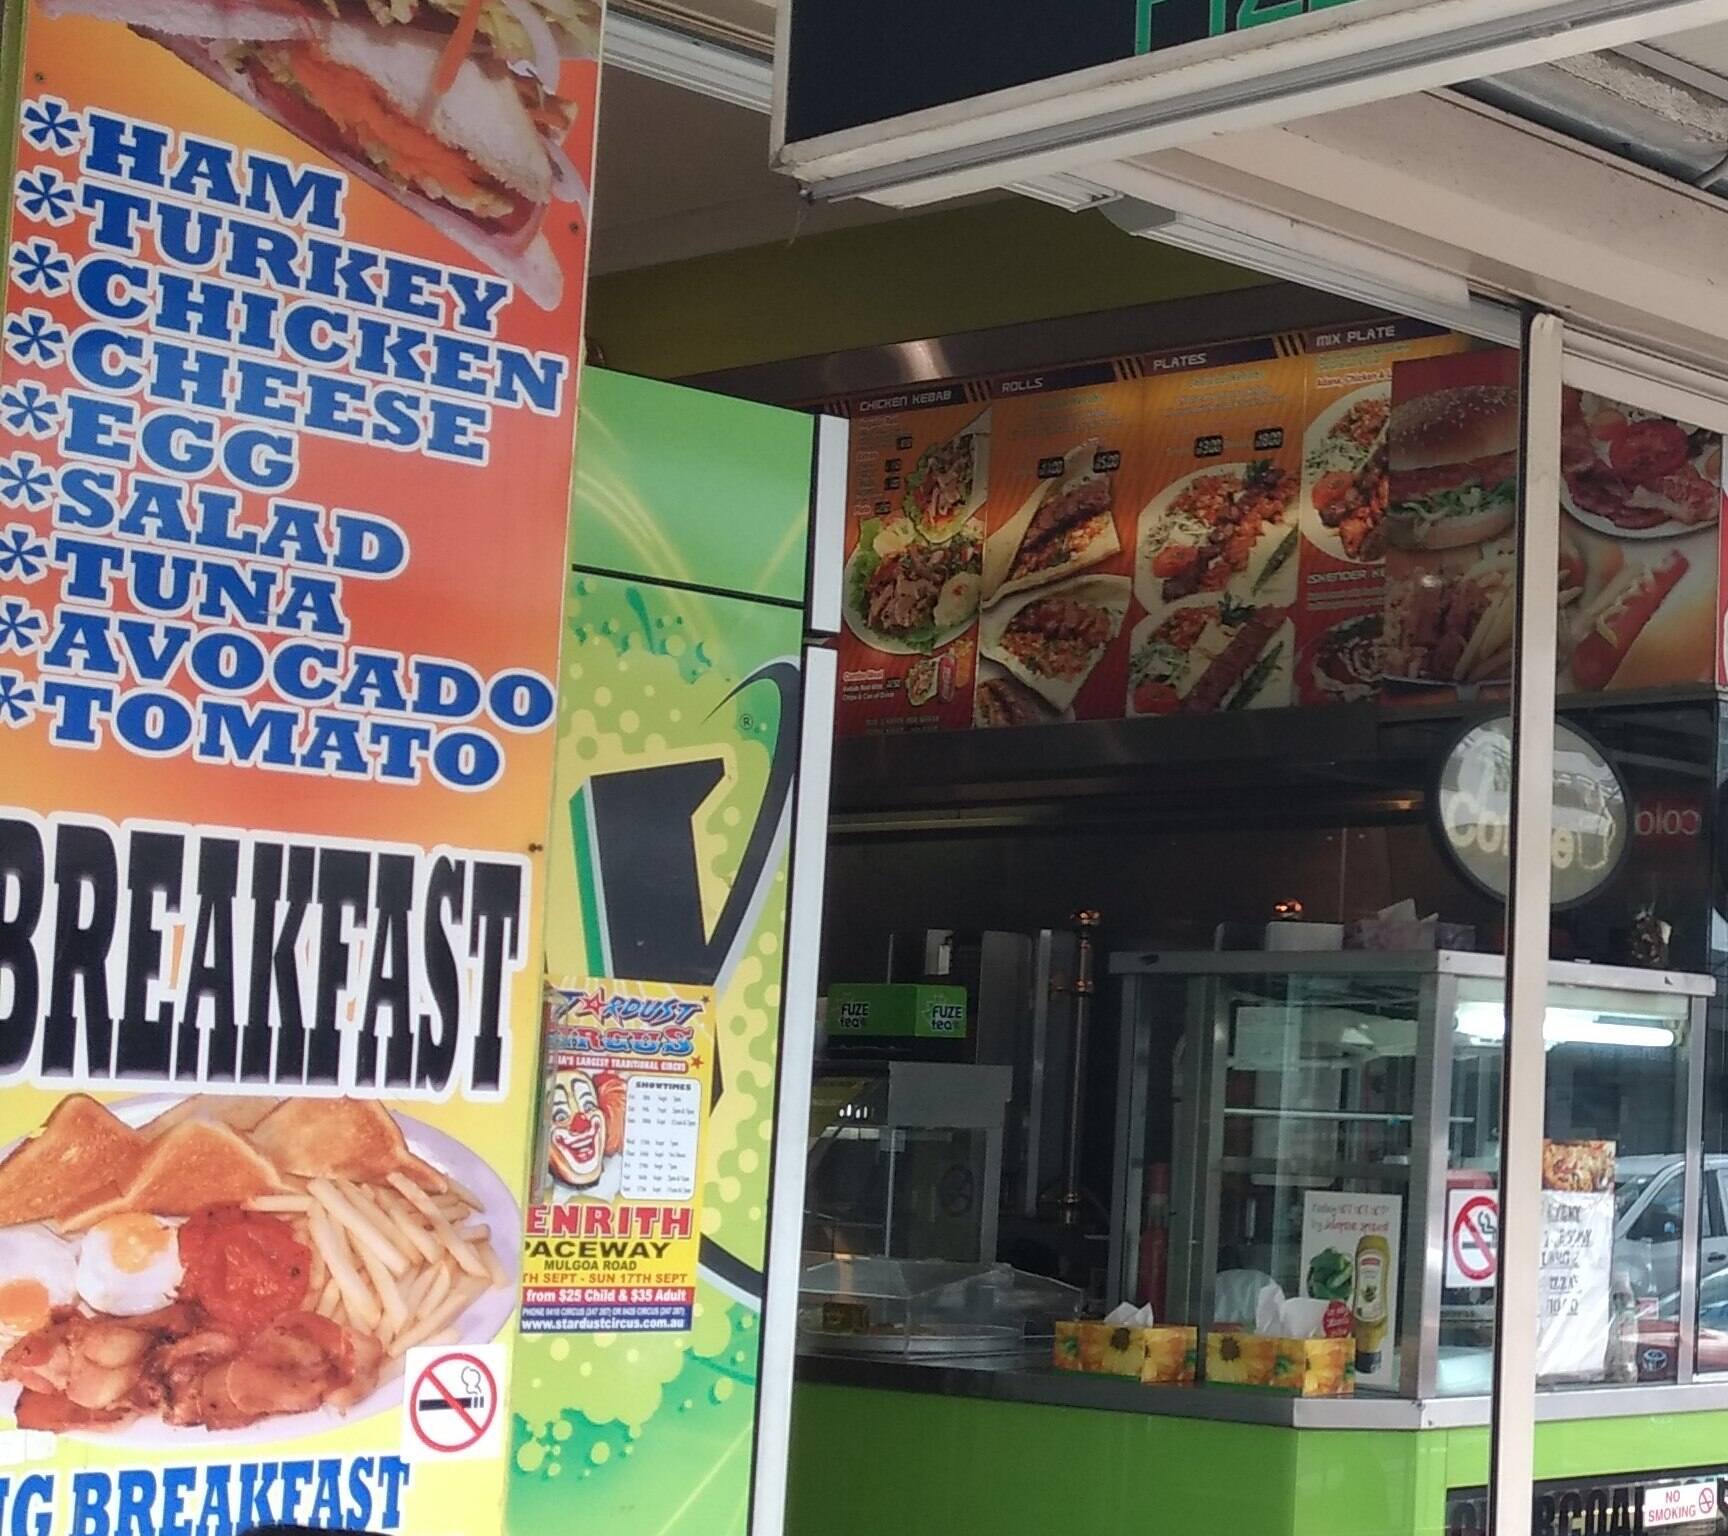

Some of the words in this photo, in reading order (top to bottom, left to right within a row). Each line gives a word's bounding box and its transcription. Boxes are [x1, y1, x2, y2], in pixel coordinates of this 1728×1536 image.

[1316, 333, 1341, 348] MIX
[1347, 325, 1395, 343] PLATE
[1153, 352, 1207, 371] PLATES
[1002, 377, 1044, 393] ROLLS
[859, 396, 908, 413] CHICKEN
[912, 390, 952, 406] KEBAB
[0, 820, 523, 1092] BREAKFAST
[841, 1003, 869, 1016] FUZE
[932, 1005, 963, 1018] FUZE
[840, 1017, 859, 1028] tea
[931, 1019, 952, 1030] tea
[547, 1025, 694, 1056] IRCUS
[635, 1081, 691, 1091] SHOWTIMES
[526, 1205, 693, 1239] ENRITH
[544, 1260, 598, 1270] MULGOA
[603, 1261, 637, 1271] ROAD
[543, 1274, 576, 1283] SEPT
[589, 1274, 615, 1283] SUN
[621, 1274, 651, 1283] 17TH
[655, 1274, 688, 1284] SEPT
[526, 1289, 556, 1301] from
[559, 1289, 583, 1302] $25
[585, 1289, 616, 1302] Child
[618, 1290, 629, 1302] &
[631, 1290, 653, 1302] $35
[655, 1289, 687, 1302] Adult
[522, 1318, 684, 1330] www.stardustcircus.com.au
[1665, 1491, 1681, 1503] NO
[1648, 1504, 1697, 1524] SMOKING
